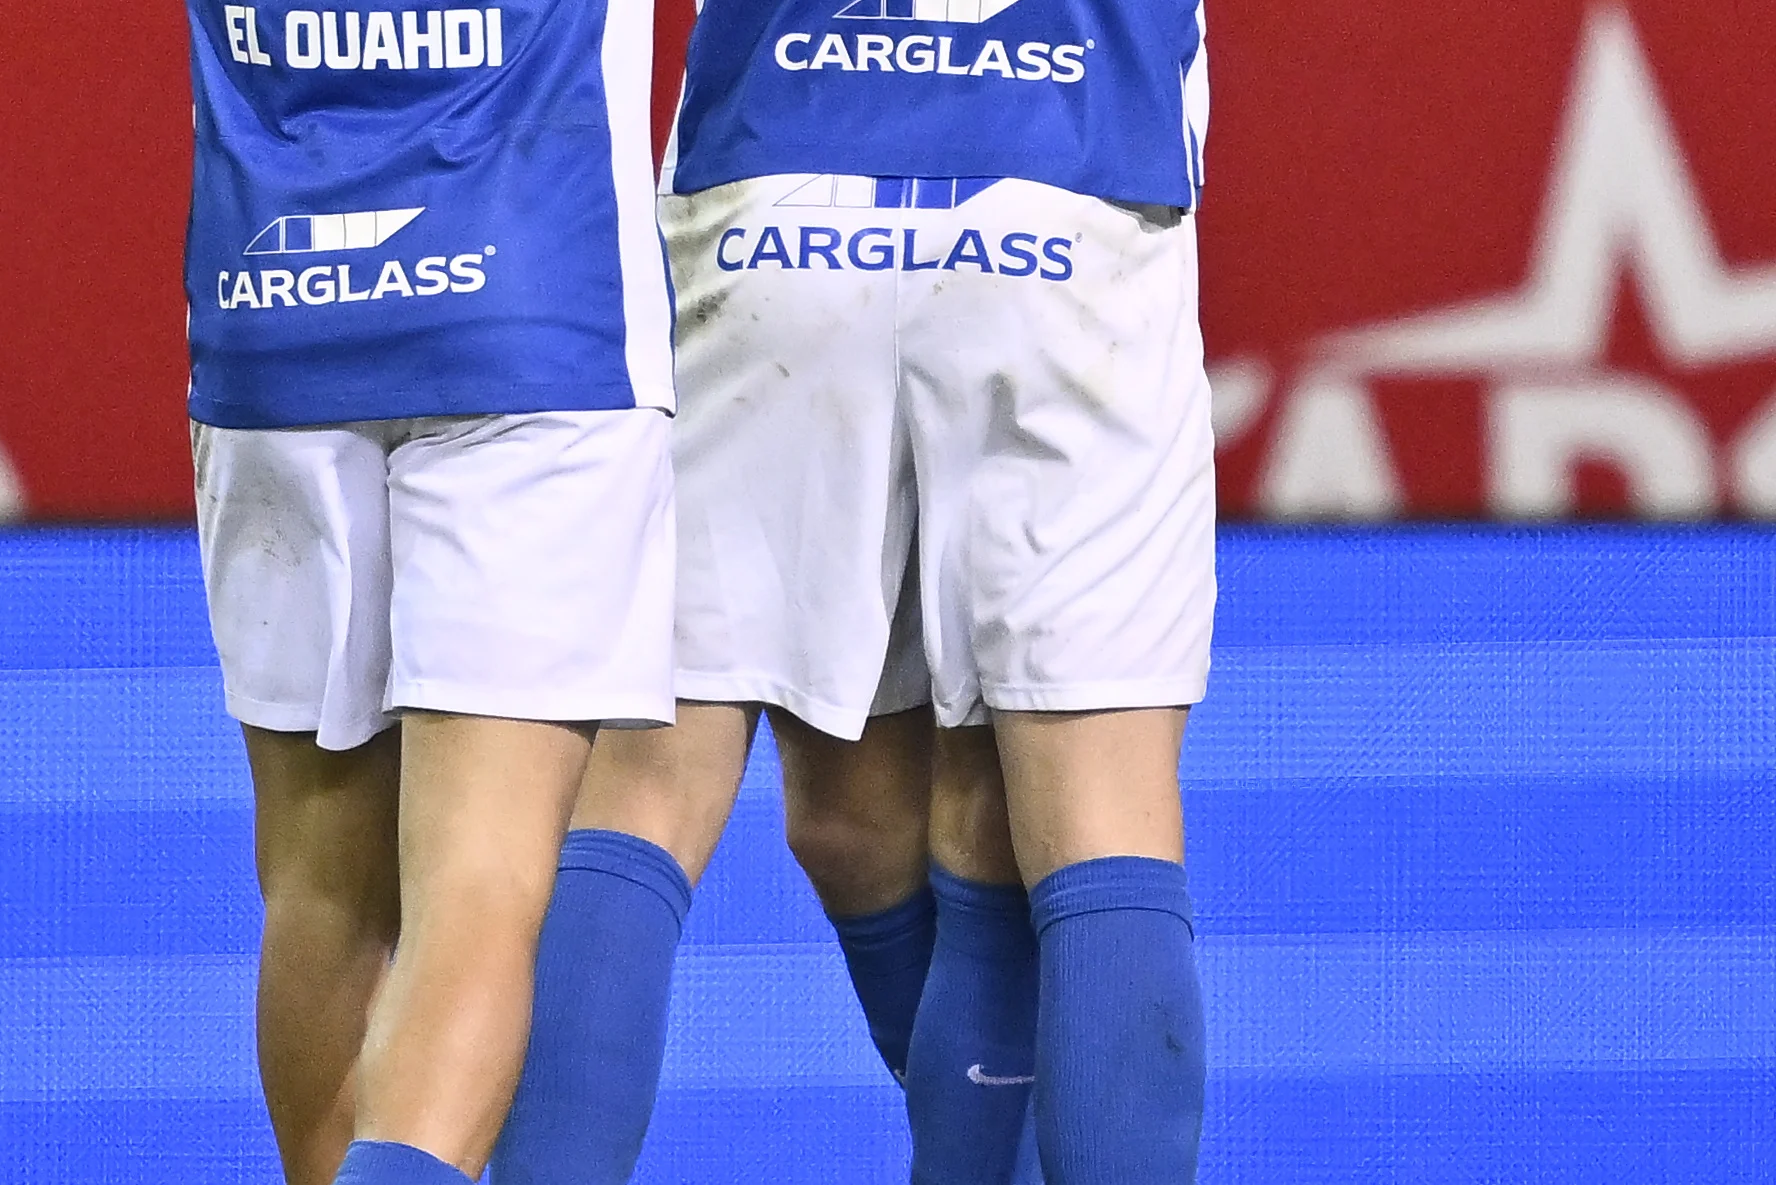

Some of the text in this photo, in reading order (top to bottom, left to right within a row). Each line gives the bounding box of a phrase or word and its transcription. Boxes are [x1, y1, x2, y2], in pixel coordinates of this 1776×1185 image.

[225, 4, 503, 70] EL OUAHDI
[774, 32, 1086, 84] CARGLASS
[218, 253, 487, 309] CARGLASS
[716, 226, 1074, 282] CARGLASS
